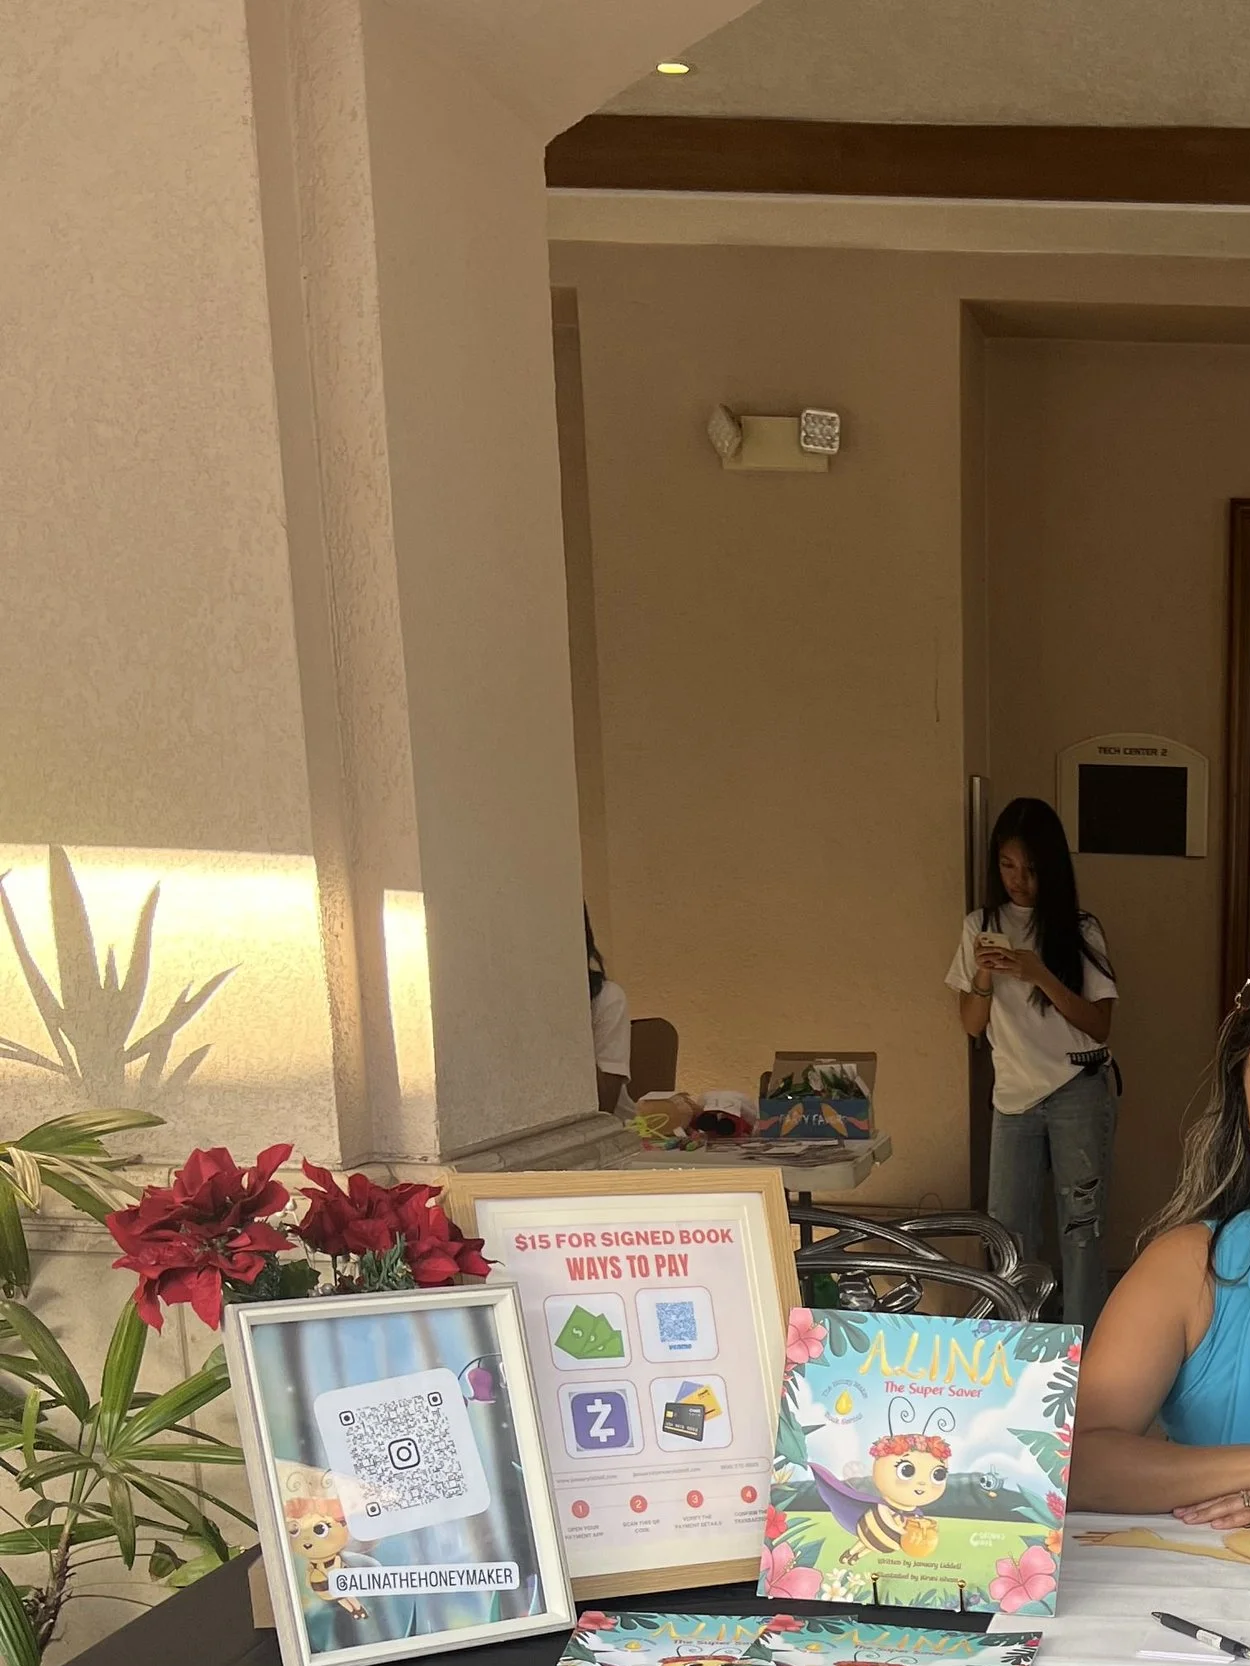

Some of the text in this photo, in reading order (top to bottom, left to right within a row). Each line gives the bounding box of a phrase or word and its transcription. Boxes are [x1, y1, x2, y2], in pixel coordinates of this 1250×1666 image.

[1097, 746, 1168, 756] TECH CENTER 2
[514, 1228, 734, 1251] $15 FOR SIGNED BOOK
[565, 1253, 689, 1281] WAYS TO PAY
[857, 1330, 1015, 1388] ALINA
[884, 1380, 983, 1399] The Super Saver
[336, 1568, 513, 1591] @ALINATHEHONEYMAKER
[651, 1621, 768, 1641] ALIN
[832, 1628, 973, 1654] ALINA
